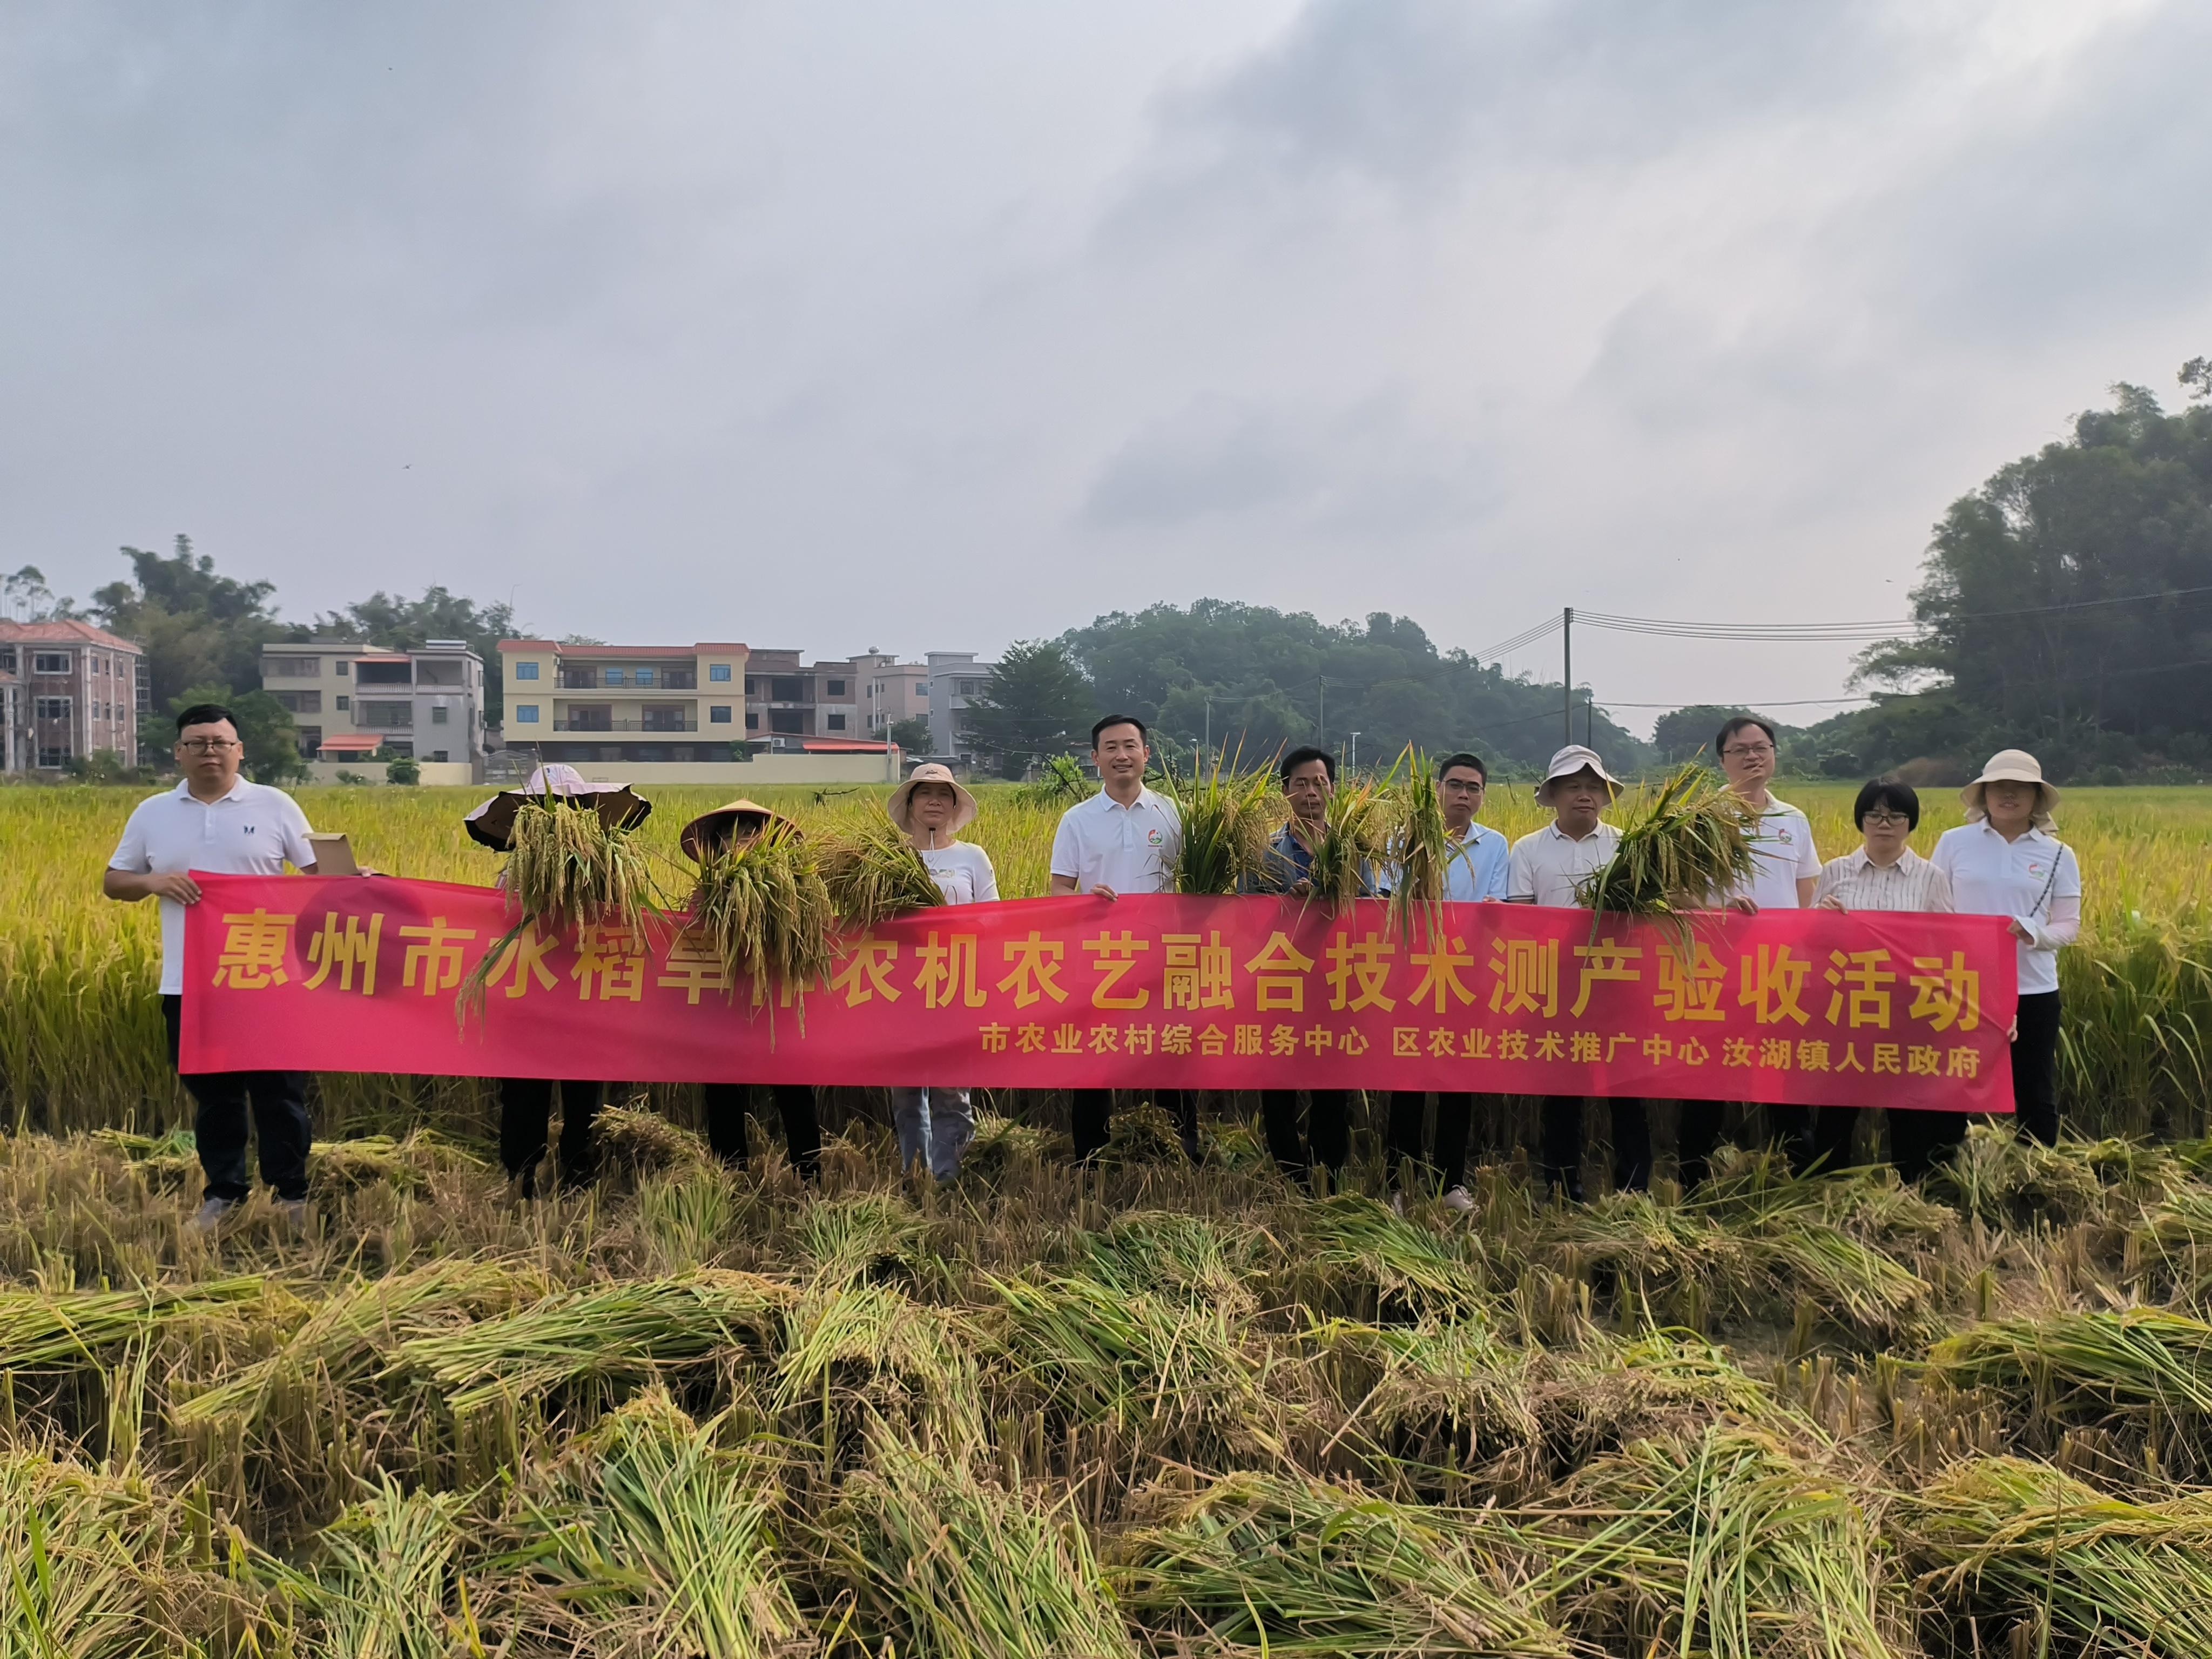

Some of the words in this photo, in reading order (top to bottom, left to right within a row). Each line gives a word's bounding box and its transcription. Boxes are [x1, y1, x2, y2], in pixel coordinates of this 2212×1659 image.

[212, 908, 1980, 1032] 惠州市水稻旱农机农艺融合技术测产验收活动
[979, 1022, 1369, 1056] 市农业农村综合服务中心
[1393, 1026, 1710, 1066] 区农业技术推广中心
[1722, 1036, 1981, 1078] 汝湖镇人民政府
